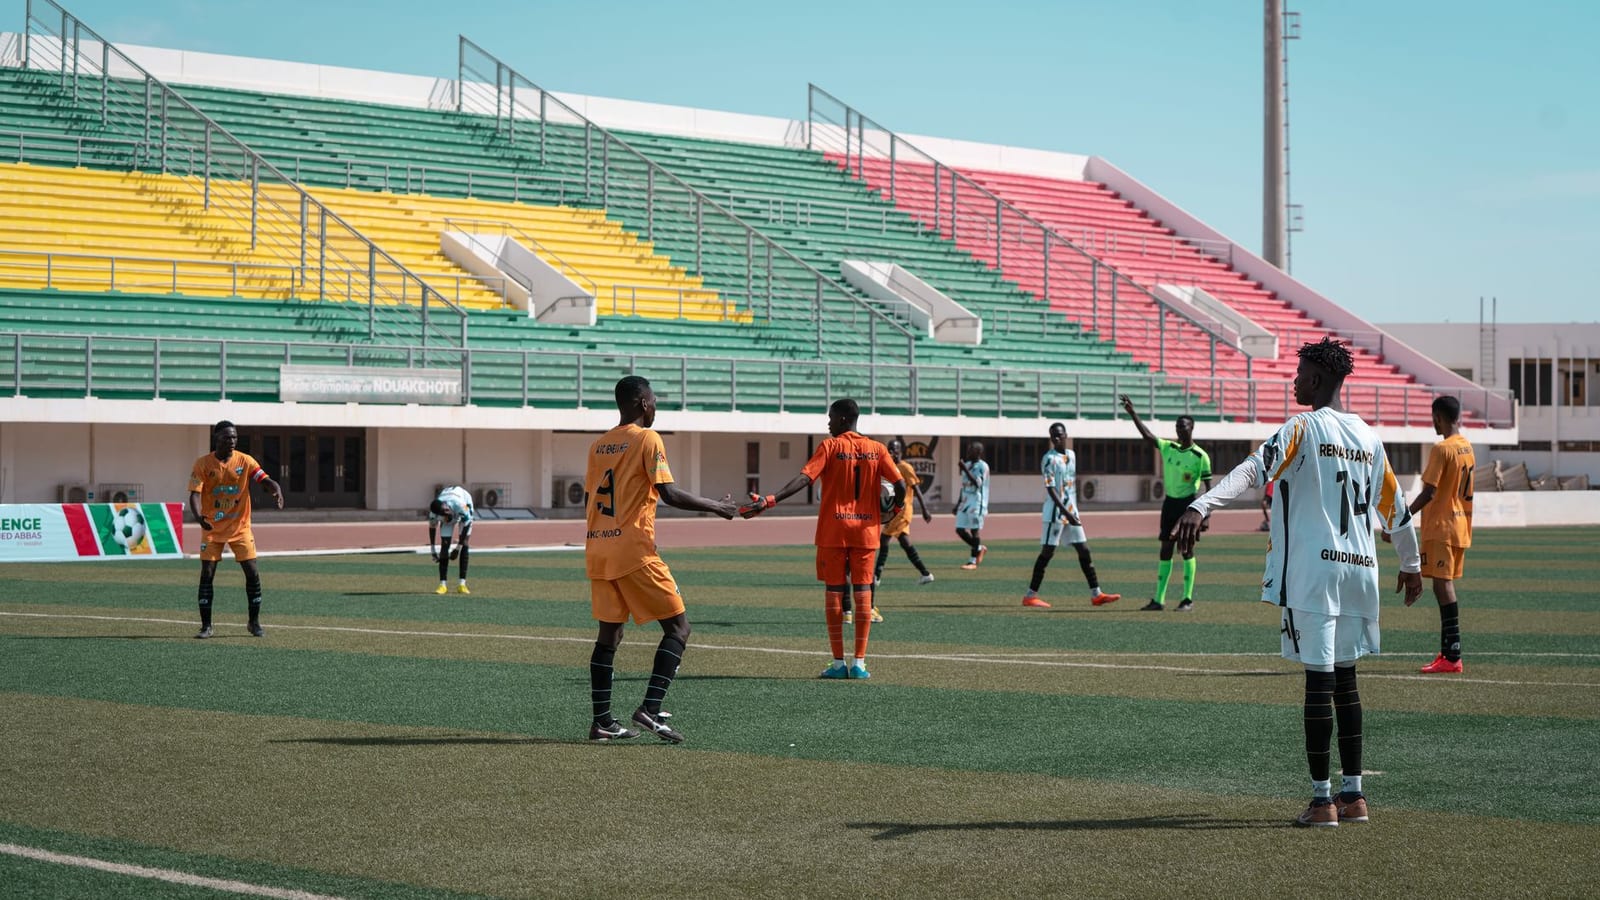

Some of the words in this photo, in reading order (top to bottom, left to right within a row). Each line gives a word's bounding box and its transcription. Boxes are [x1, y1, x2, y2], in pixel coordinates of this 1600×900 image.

[373, 380, 459, 394] NOUAKCHOTT
[854, 465, 860, 500] 1
[1336, 470, 1371, 539] 14
[0, 518, 41, 530] ENGE
